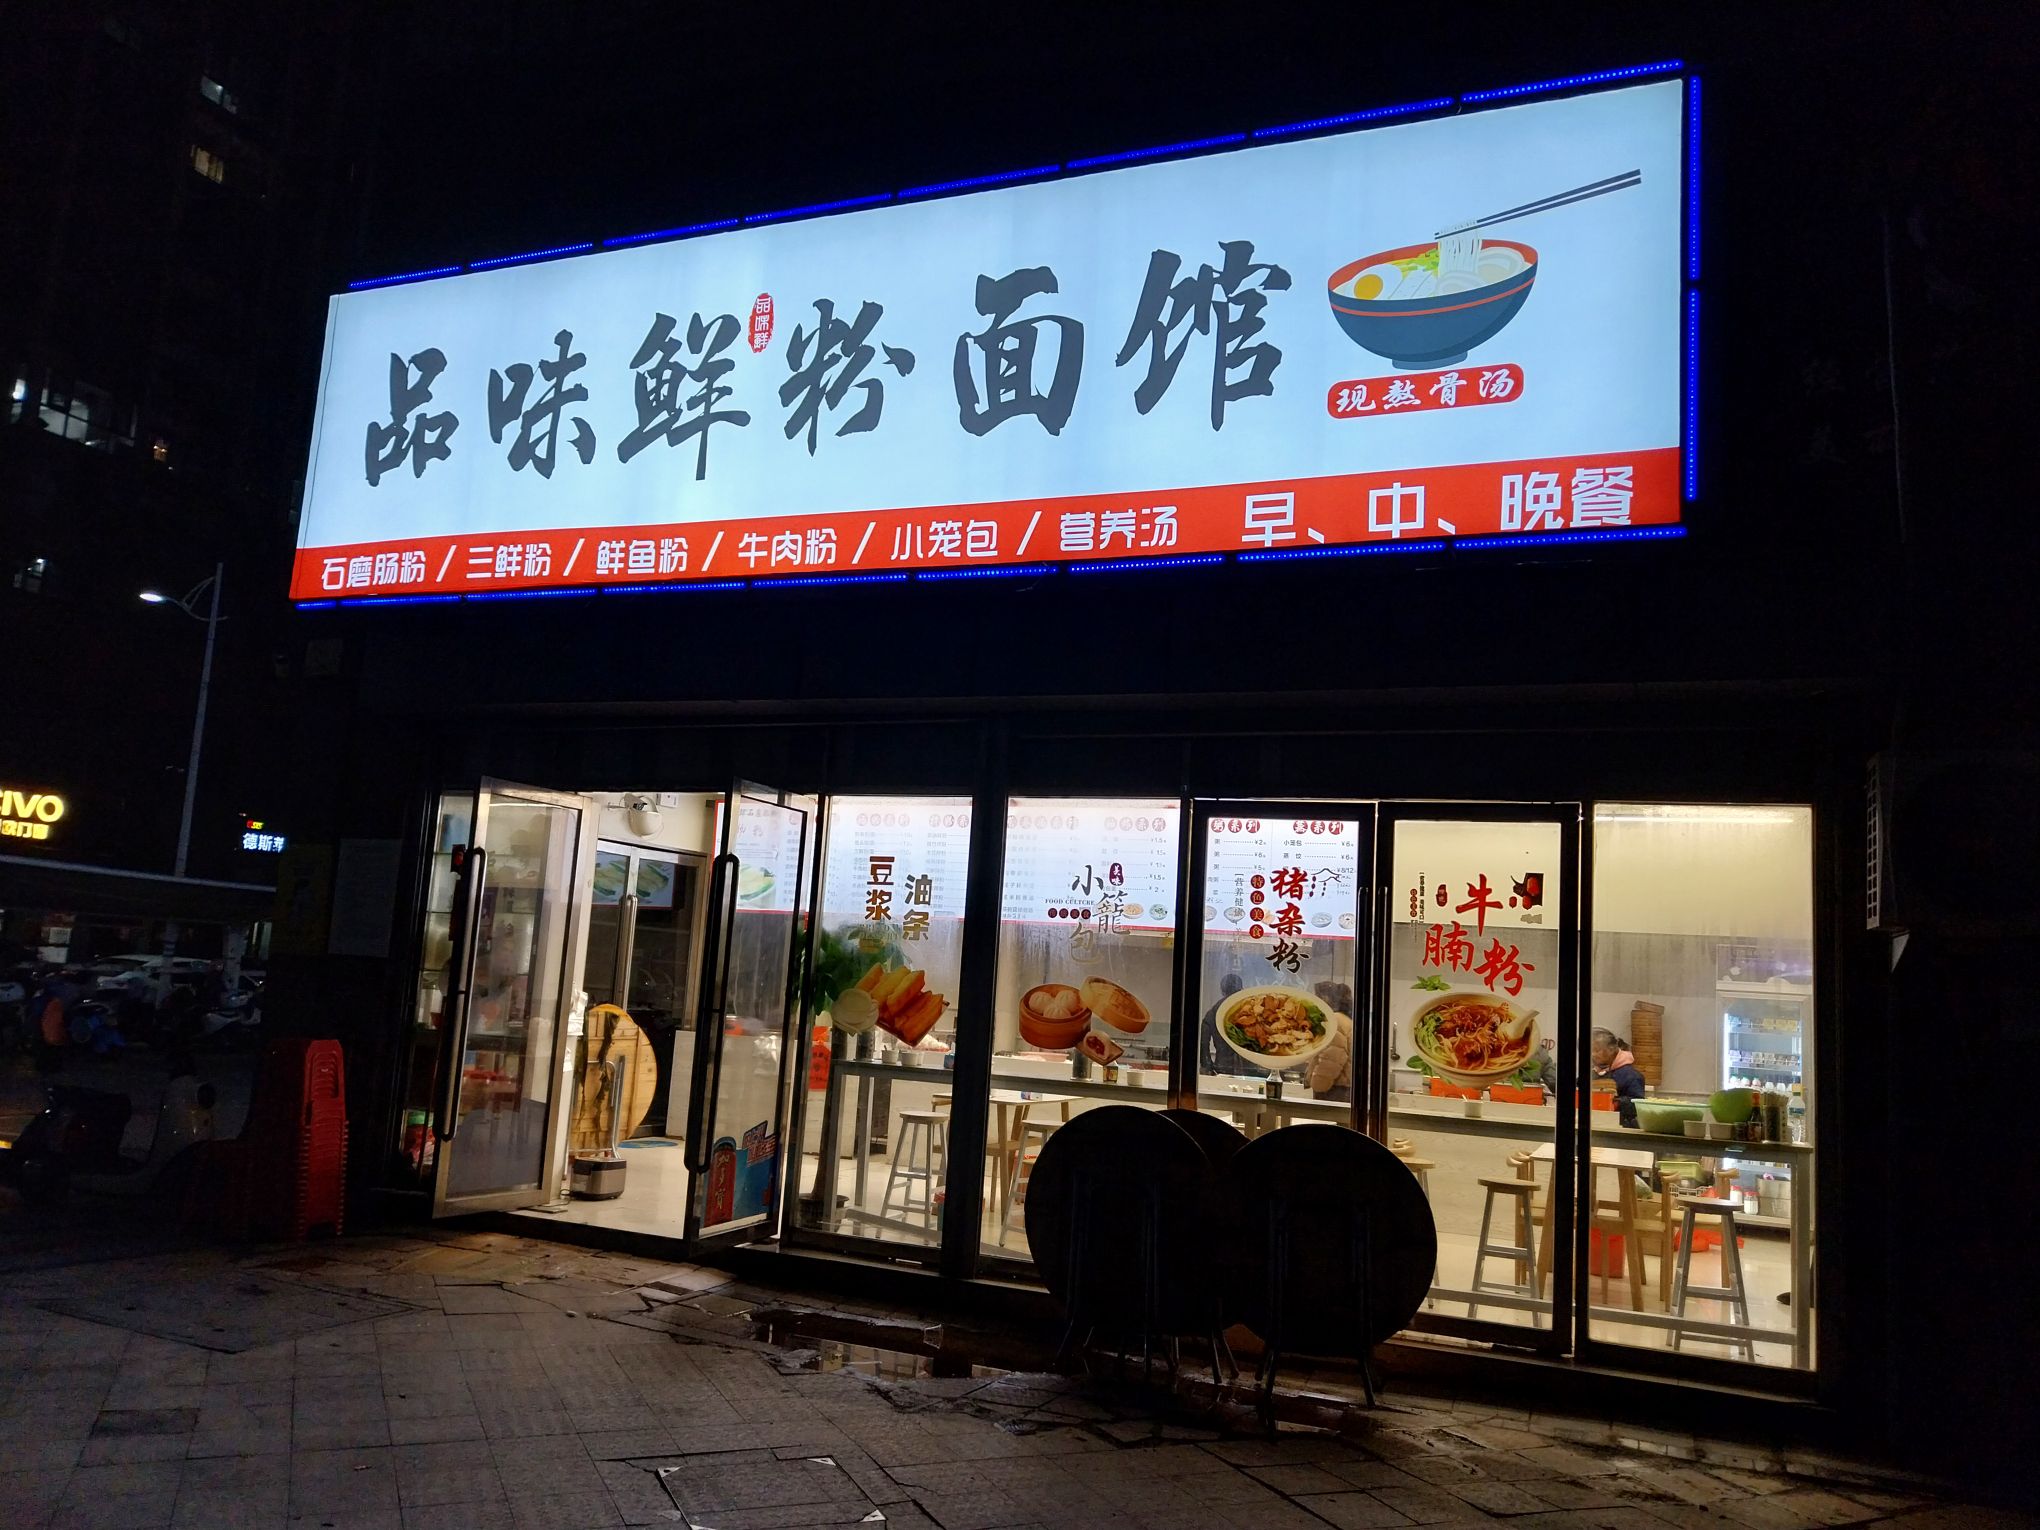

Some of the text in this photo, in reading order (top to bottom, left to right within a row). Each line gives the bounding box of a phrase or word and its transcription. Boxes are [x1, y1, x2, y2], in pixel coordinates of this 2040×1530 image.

[753, 297, 771, 350] 品味鲜
[366, 241, 1292, 487] 品味鲜粉面馆
[1336, 368, 1515, 413] 现熬骨汤
[321, 506, 1178, 590] 石磨肠粉 三鲜粉 鲜鱼粉 牛肉粉 小笼包 营养汤
[0, 790, 64, 822] IVO
[864, 856, 895, 920] 豆浆
[902, 874, 932, 941] 油条
[1250, 875, 1265, 939] 特色美食
[1265, 867, 1309, 973] 猪杂粉
